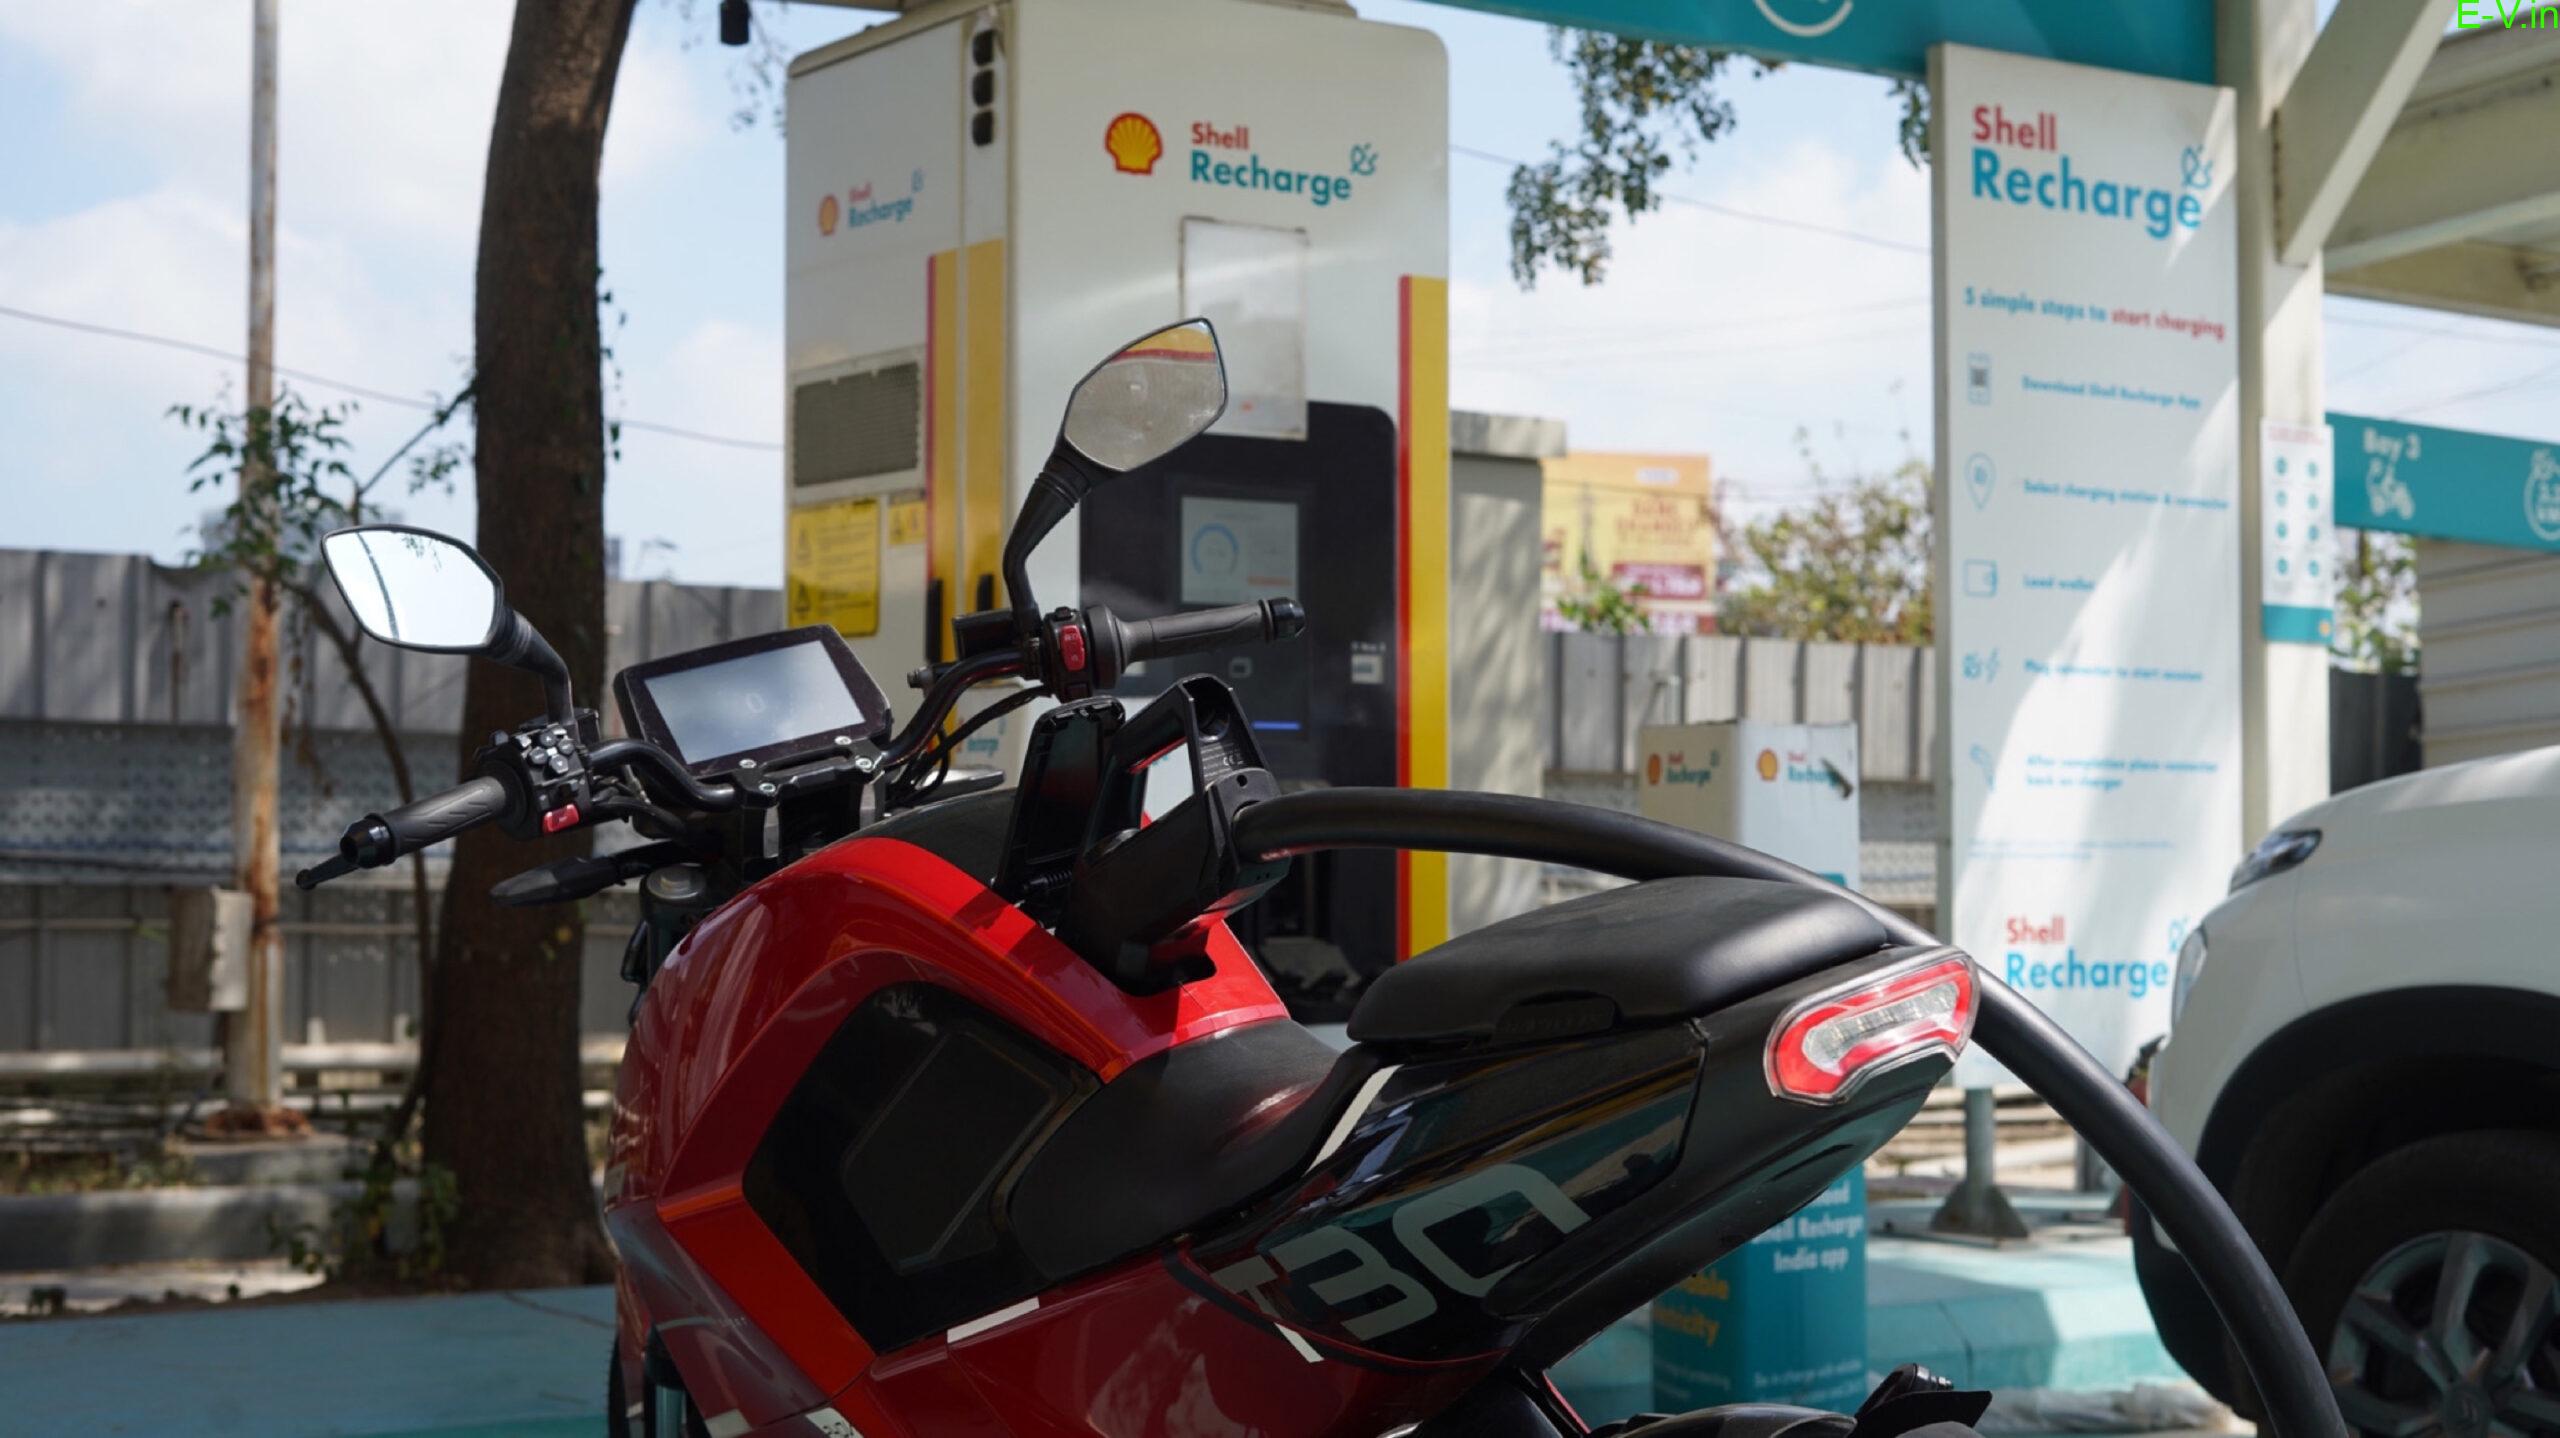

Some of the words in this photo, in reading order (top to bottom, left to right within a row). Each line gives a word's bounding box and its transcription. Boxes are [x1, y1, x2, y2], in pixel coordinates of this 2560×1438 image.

[1191, 121, 1250, 150] Shell
[1972, 102, 2058, 151] Shell
[1191, 149, 1352, 207] Recharge
[1972, 147, 2201, 240] Recharge
[848, 197, 913, 229] Recharge
[1965, 286, 1975, 306] 5
[1981, 290, 2034, 313] simple
[2042, 300, 2084, 320] steps
[2089, 304, 2106, 320] to
[2112, 309, 2150, 327] start
[2156, 311, 2225, 341] charging
[2363, 427, 2403, 462] Bay
[2406, 433, 2421, 461] 3
[1666, 765, 1711, 787] Recharge
[2006, 915, 2065, 944] Shell
[2006, 947, 2169, 998] Recharge
[1798, 1212, 1864, 1238] Recharge
[1773, 1246, 1818, 1271] India
[1820, 1247, 1850, 1273] app
